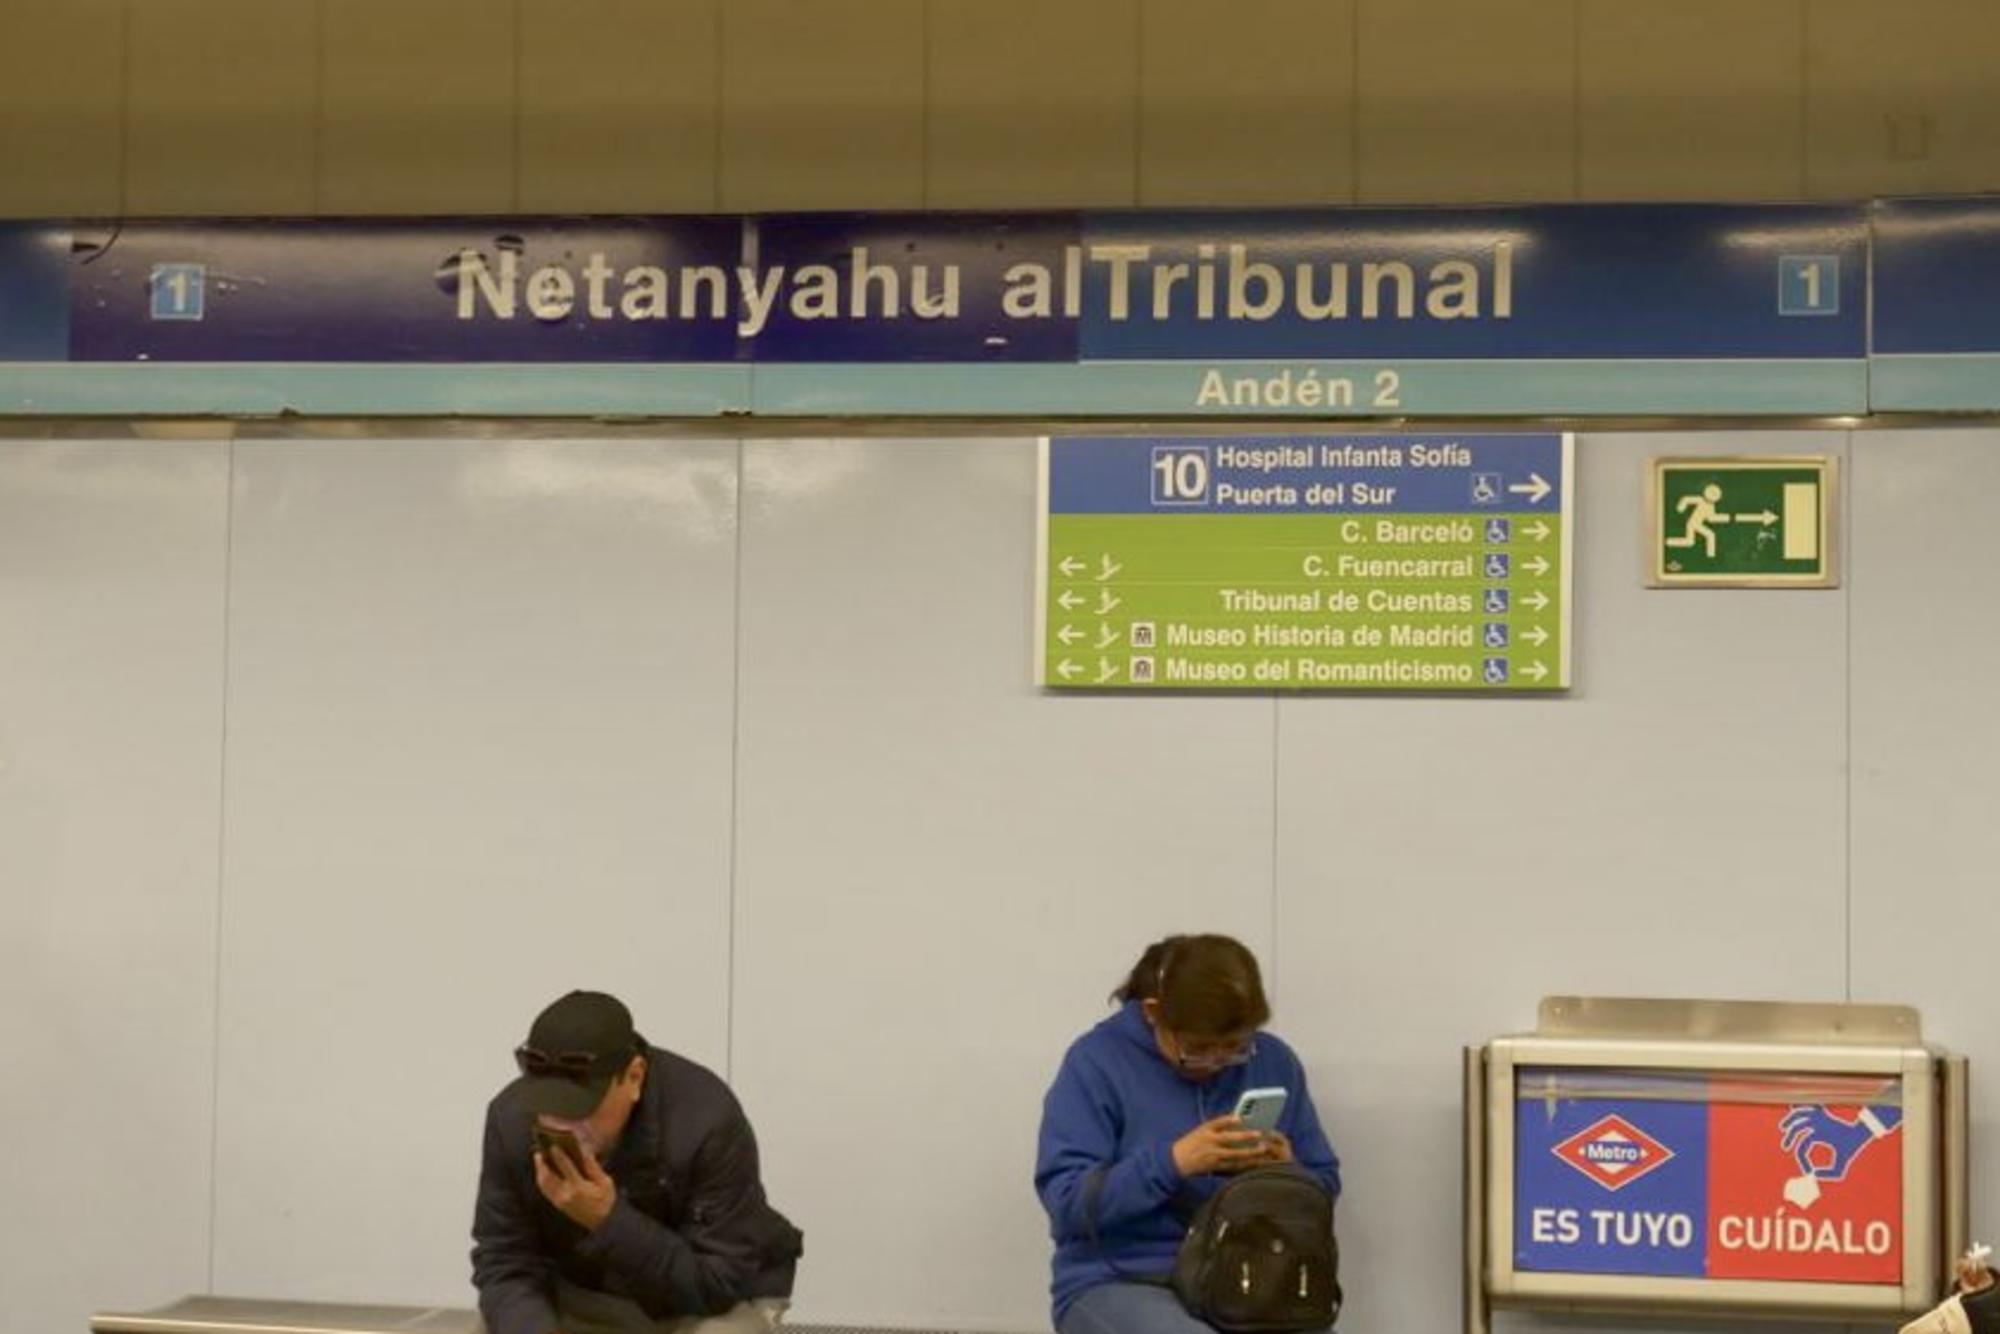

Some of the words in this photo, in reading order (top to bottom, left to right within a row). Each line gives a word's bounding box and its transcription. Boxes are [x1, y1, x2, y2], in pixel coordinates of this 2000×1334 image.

[167, 273, 186, 311] 1
[455, 247, 961, 339] Netanyahu
[1799, 264, 1819, 307] 1
[1196, 368, 1353, 408] Andén
[1373, 370, 1401, 408] 2
[1216, 445, 1315, 472] Hospital
[1321, 445, 1401, 468] Infanta
[1409, 444, 1472, 468] Sofía
[1155, 454, 1207, 498] 10
[1216, 484, 1298, 505] Puerta
[1305, 483, 1343, 505] del
[1351, 483, 1396, 505] Sur
[1340, 521, 1368, 544] C.
[1376, 520, 1474, 544] Barceló
[1302, 556, 1330, 577] C.
[1338, 555, 1473, 577] Fuencarral
[1220, 590, 1320, 613] Tribunal
[1329, 590, 1362, 612] de
[1368, 590, 1473, 613] Cuentas
[1166, 625, 1247, 647] Museo
[1253, 624, 1345, 647] Historia
[1351, 625, 1384, 647] de
[1390, 624, 1474, 647] Madrid
[1166, 659, 1247, 682] Museo
[1254, 659, 1290, 682] del
[1300, 659, 1473, 682] Romanticismo
[1587, 1143, 1639, 1162] Metro
[1531, 1208, 1580, 1244] ES
[1590, 1209, 1694, 1248] TUYO
[1718, 1207, 1892, 1256] CUÍDALO
